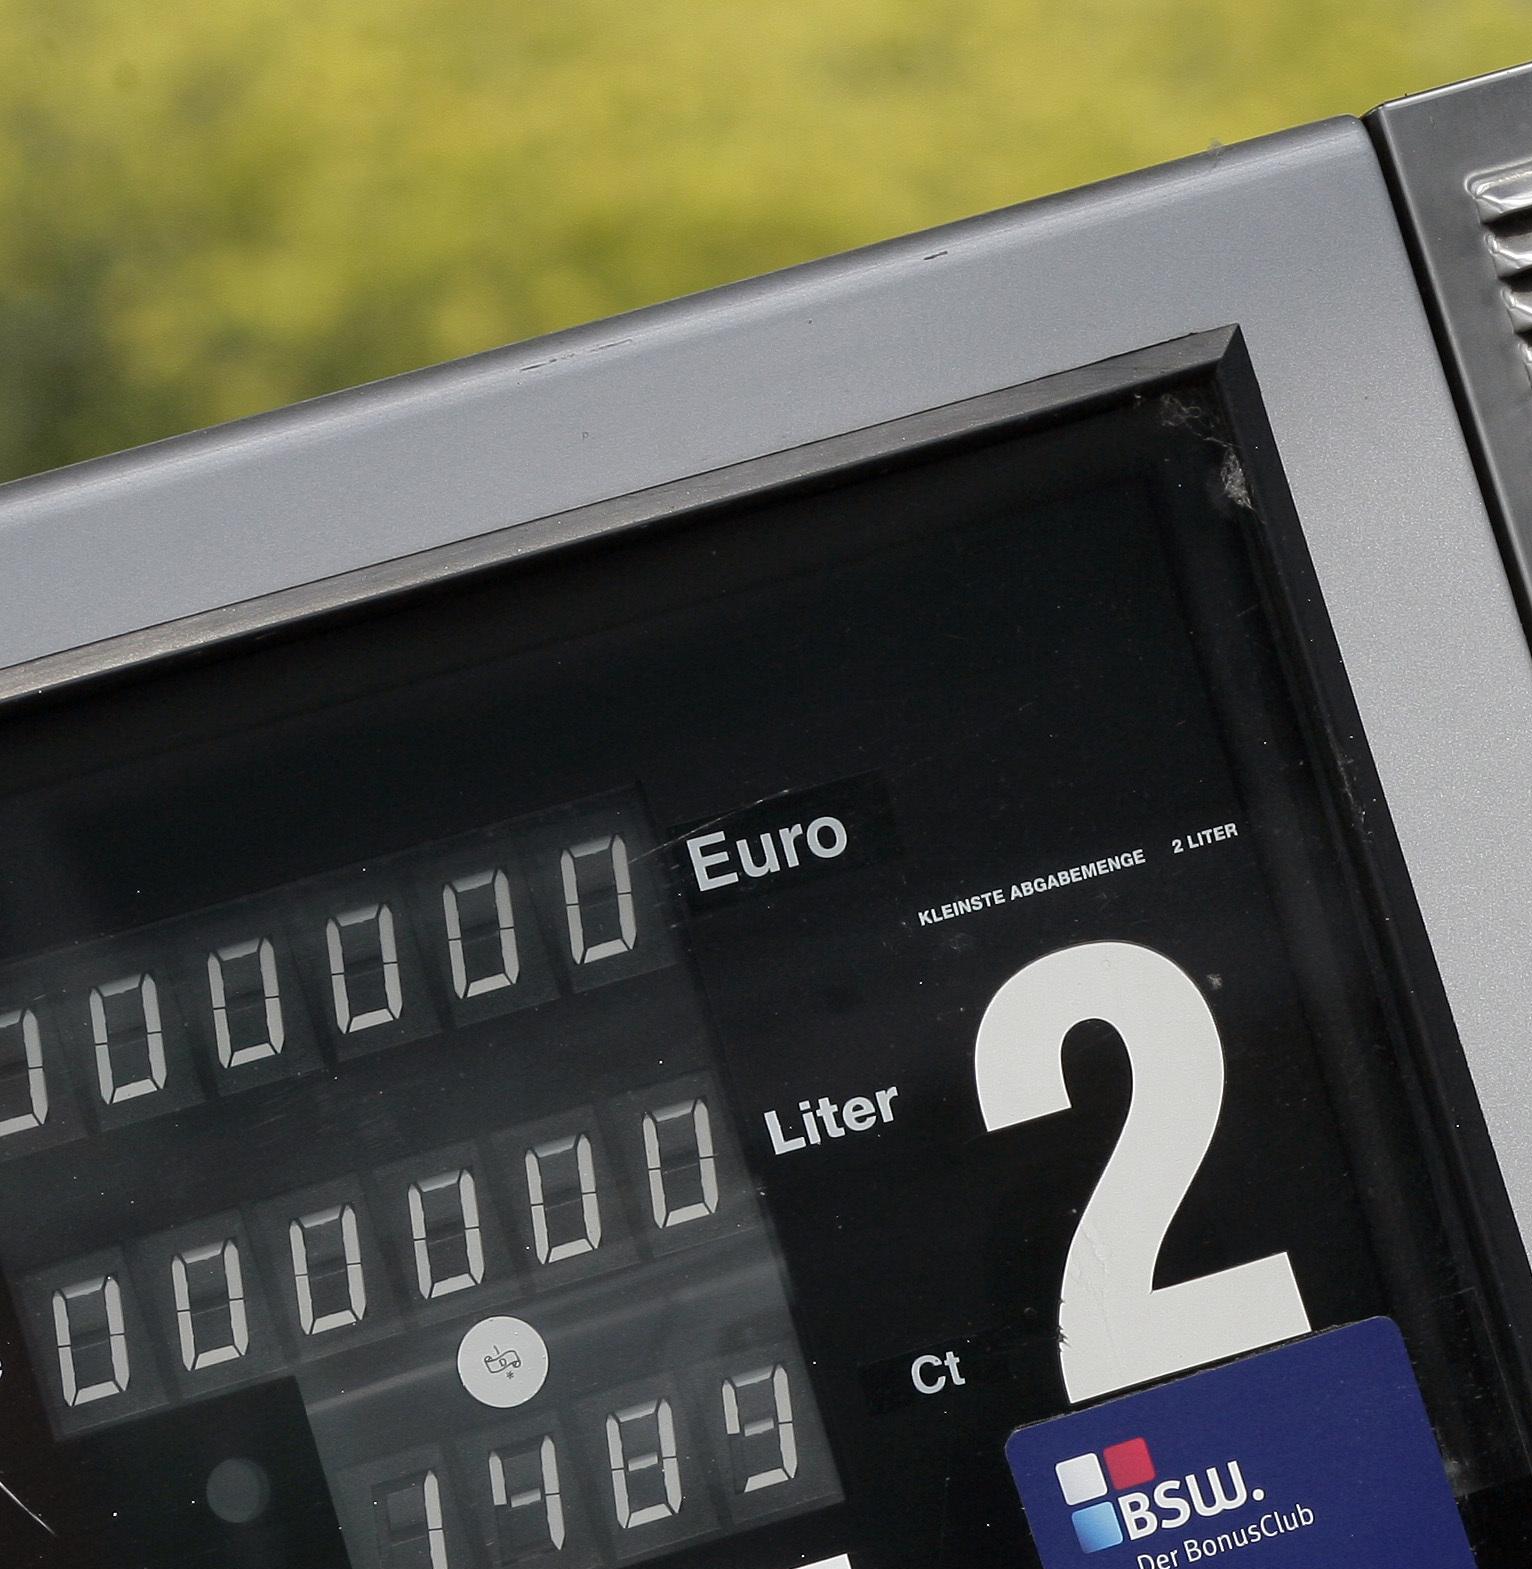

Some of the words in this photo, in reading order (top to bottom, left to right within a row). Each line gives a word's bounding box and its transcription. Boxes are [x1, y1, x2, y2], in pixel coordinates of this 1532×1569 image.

[685, 815, 848, 892] Euro
[918, 889, 1006, 926] KLEINSTE
[1010, 849, 1146, 901] ABGABEMENGE
[1171, 839, 1184, 854] 2
[1187, 823, 1239, 850] LITER
[764, 1085, 900, 1157] Liter
[975, 941, 1312, 1403] 2
[910, 1350, 966, 1395] Ct
[1118, 1460, 1265, 1542] BSW.
[1183, 1503, 1316, 1564] BonusClub
